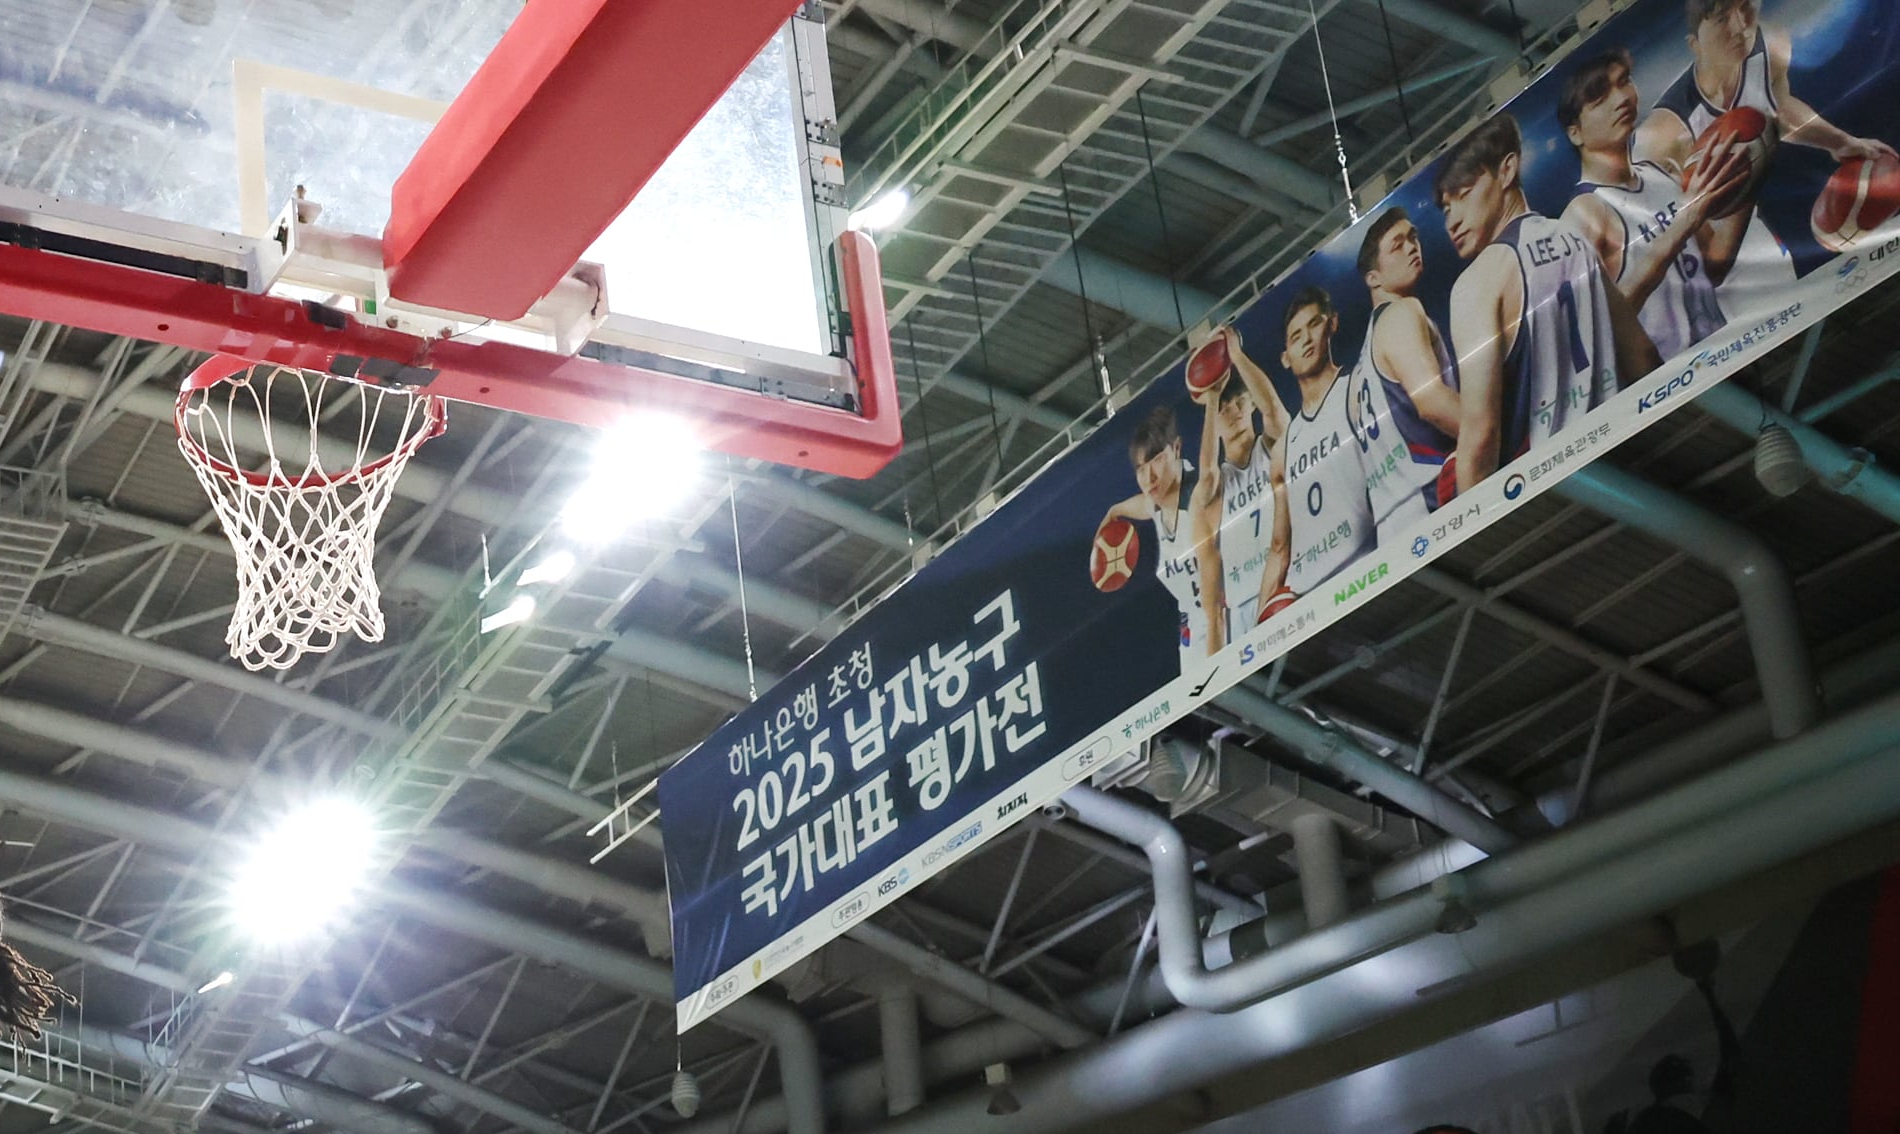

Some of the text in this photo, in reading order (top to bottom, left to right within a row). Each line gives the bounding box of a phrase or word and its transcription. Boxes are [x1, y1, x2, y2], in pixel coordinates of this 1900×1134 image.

[1527, 236, 1560, 267] LEE
[1557, 281, 1590, 374] 1
[1639, 370, 1694, 414] KSPO
[1290, 432, 1341, 483] KOREA
[1529, 423, 1611, 481] 문화체육관광부
[1228, 471, 1270, 514] KOREA
[1308, 482, 1322, 516] 0
[1250, 509, 1260, 537] 7
[1307, 520, 1352, 564] 하나은행
[1432, 504, 1481, 542] 안양시
[1333, 563, 1389, 606] NAVER
[728, 643, 874, 778] 하나은행 초청
[732, 589, 1022, 851] 2025 남자농구
[1136, 701, 1171, 731] 하나은행
[741, 662, 1046, 918] 국가대표 평가전
[997, 792, 1027, 820] 치지직
[878, 876, 898, 897] KBS
